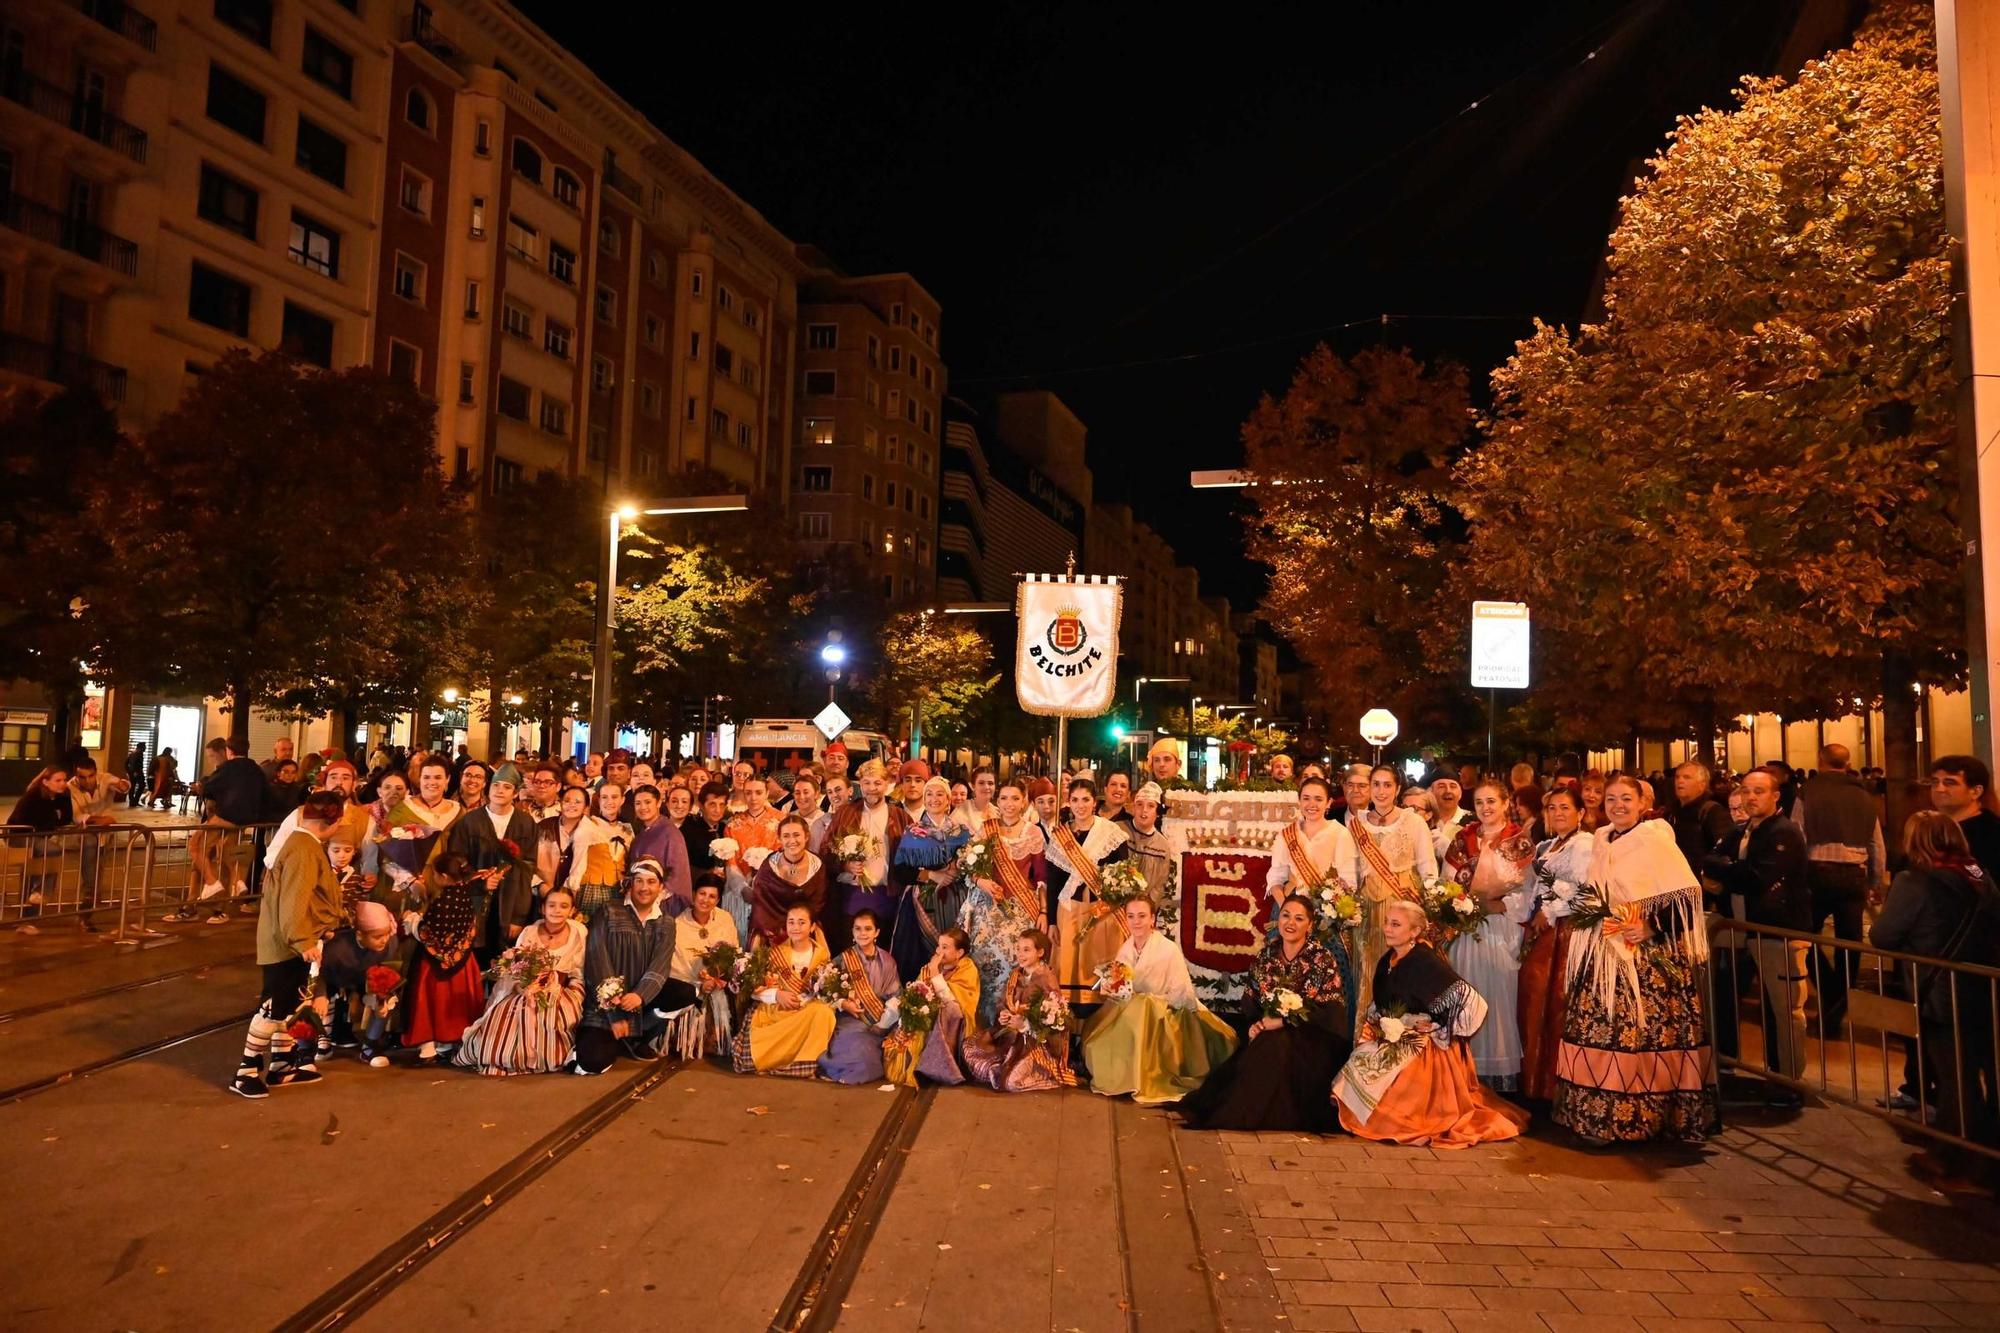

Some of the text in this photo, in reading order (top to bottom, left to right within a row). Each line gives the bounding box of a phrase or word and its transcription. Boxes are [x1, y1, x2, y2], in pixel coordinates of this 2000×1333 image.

[1029, 644, 1102, 677] BELCHITE
[748, 733, 807, 742] AMBULANCIA
[1166, 799, 1299, 822] BELCHITE
[1195, 884, 1266, 956] B
